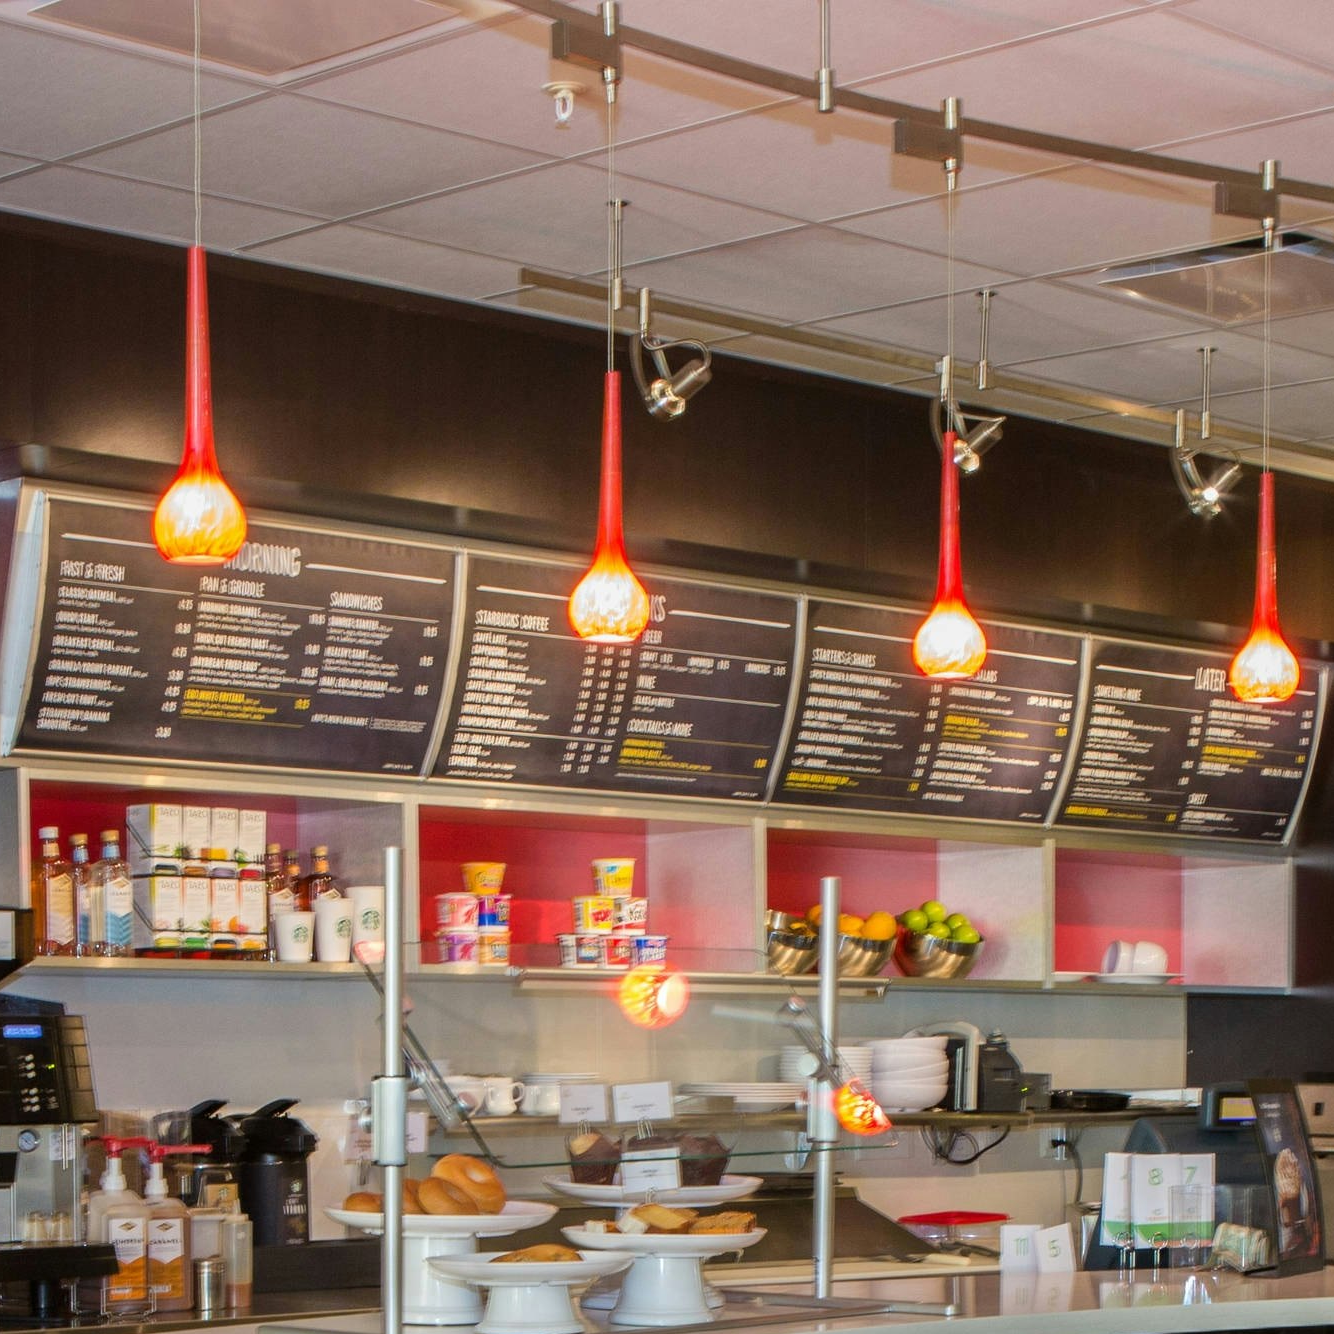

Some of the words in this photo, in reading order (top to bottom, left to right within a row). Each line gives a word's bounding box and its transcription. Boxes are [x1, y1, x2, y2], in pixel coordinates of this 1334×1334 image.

[60, 560, 85, 577] FAST
[94, 563, 125, 582] FRESH
[199, 576, 219, 592] PAN
[227, 579, 266, 598] GRIDDLE
[330, 591, 383, 612] SANDWICHES
[475, 610, 519, 629] STARBUCKS
[520, 615, 550, 632] COFFEE
[812, 648, 845, 664] STARTERS
[1195, 667, 1227, 692] LATER
[1148, 1167, 1164, 1186] 8
[1183, 1166, 1199, 1185] 7
